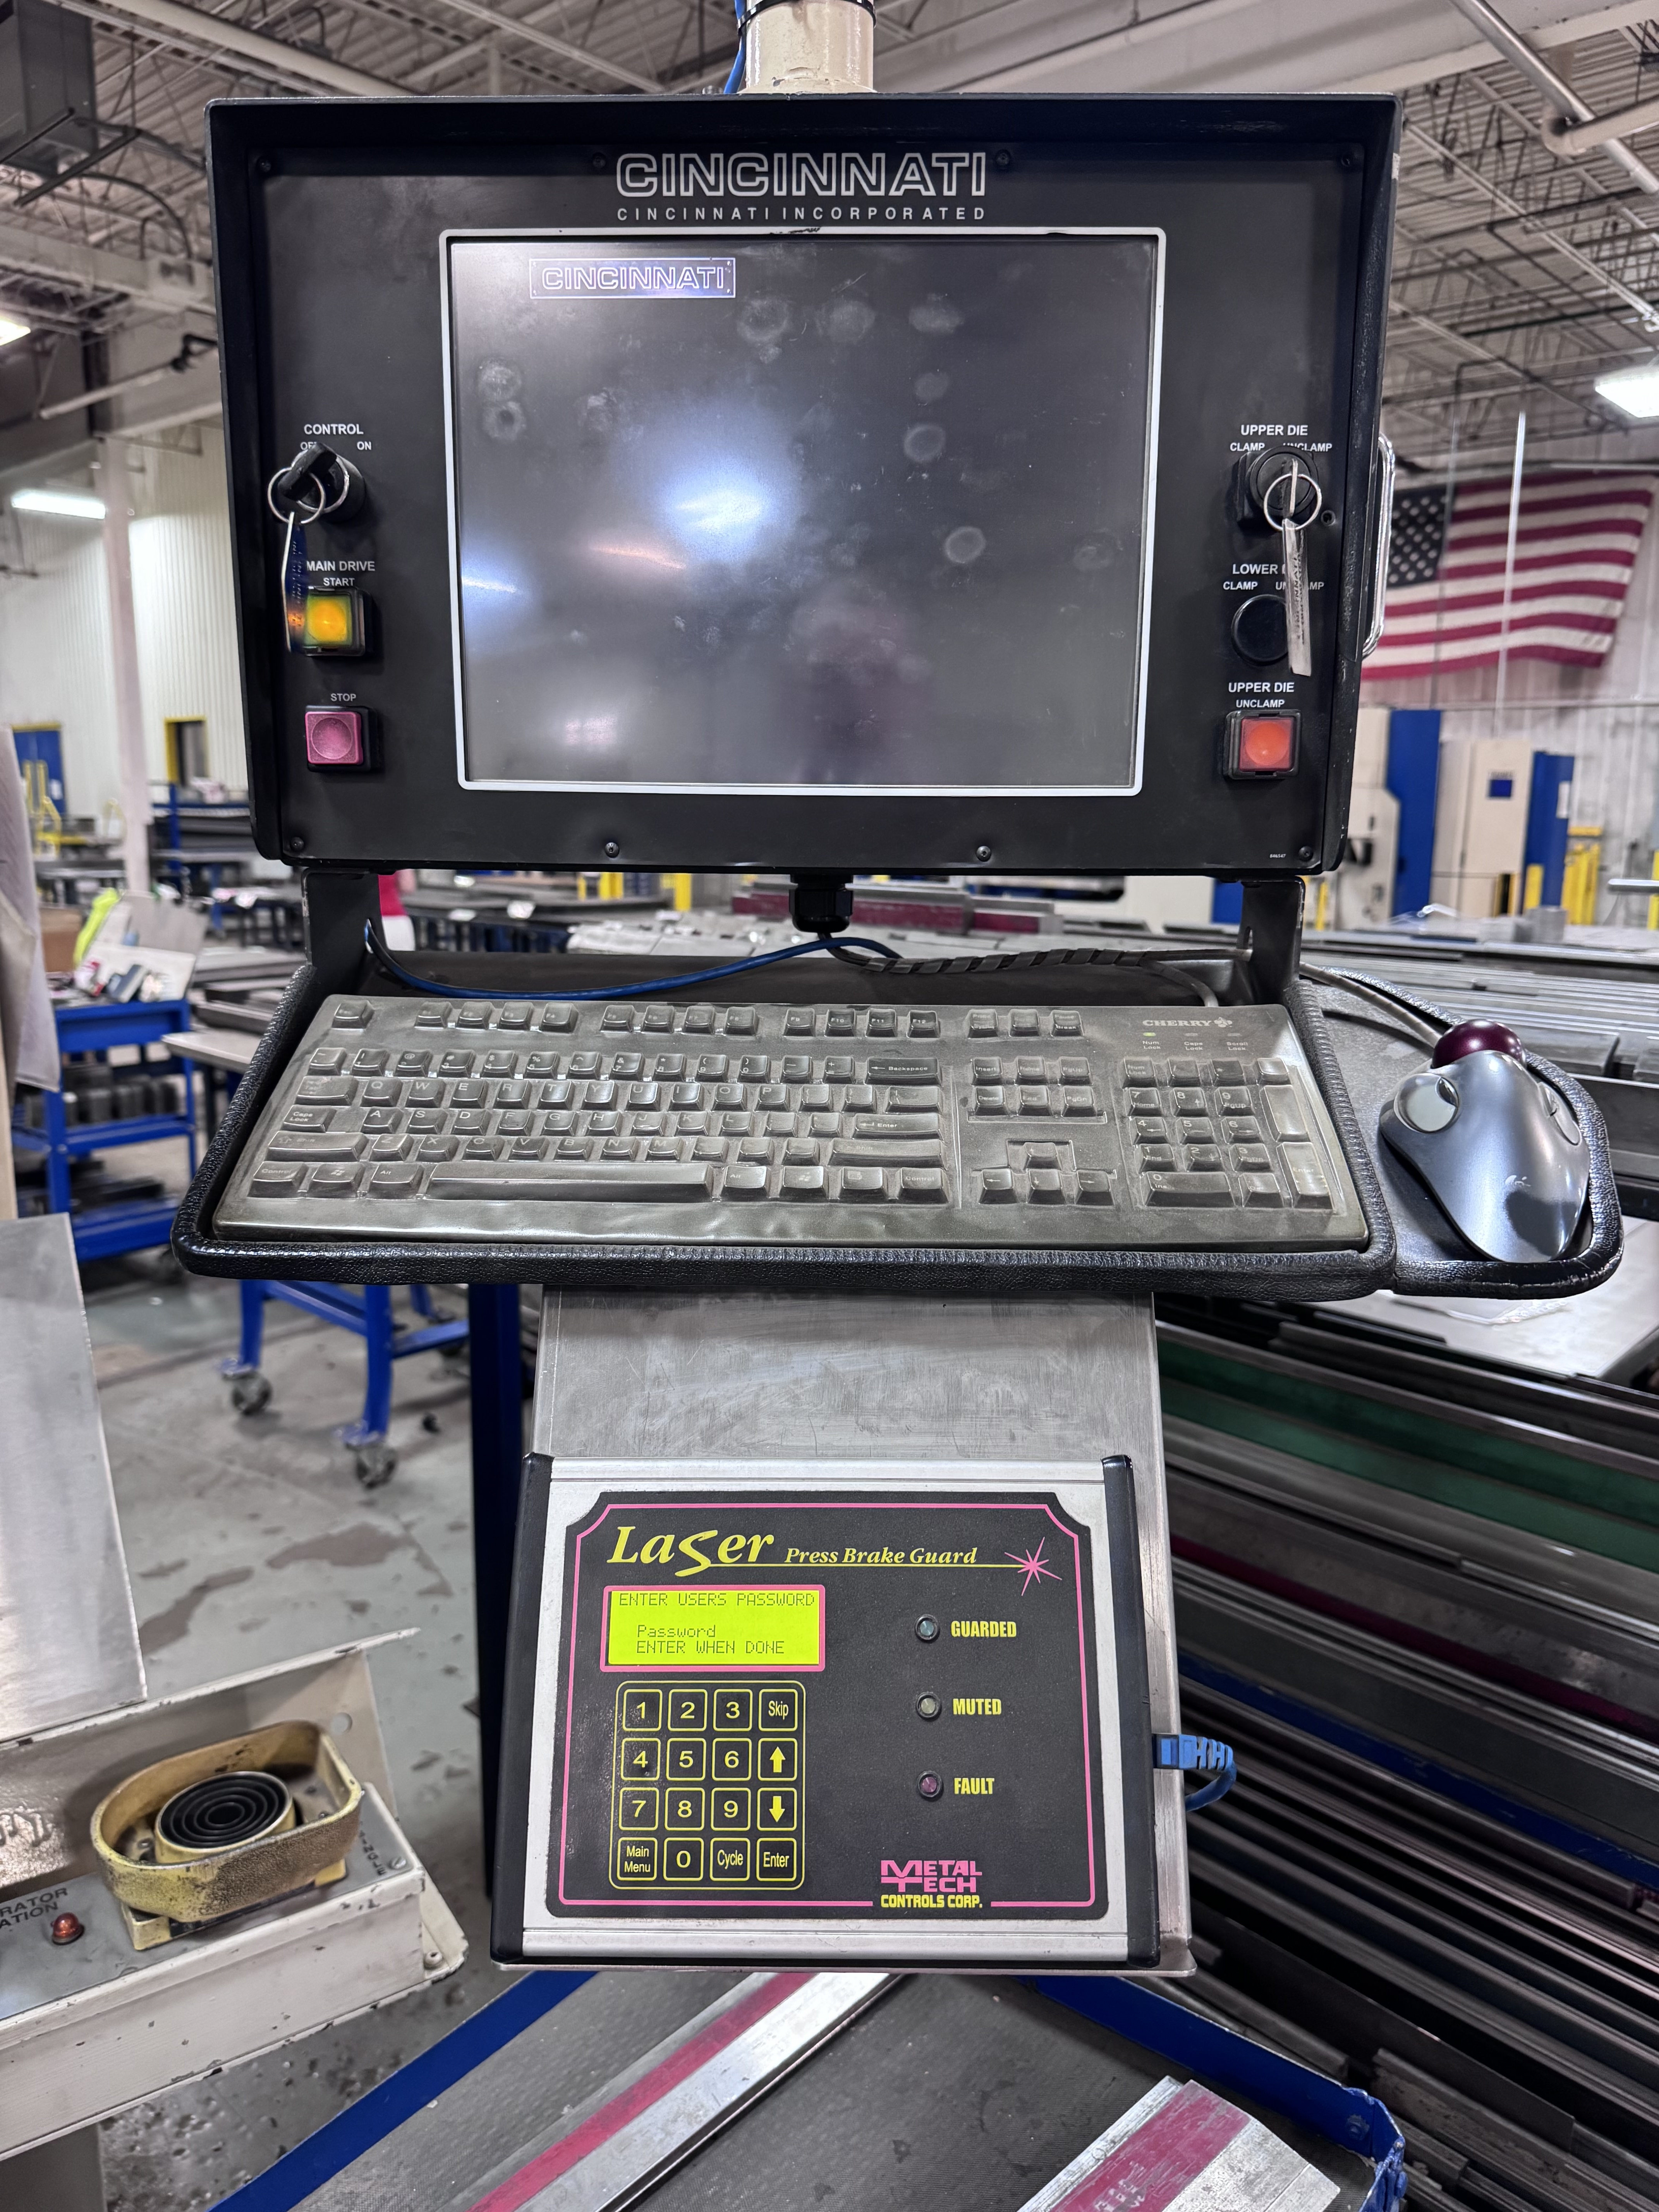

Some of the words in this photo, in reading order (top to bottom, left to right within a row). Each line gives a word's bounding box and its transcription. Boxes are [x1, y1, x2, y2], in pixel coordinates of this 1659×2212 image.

[617, 153, 986, 197] CINCINNATI
[618, 207, 769, 221] CINCINNATI
[783, 206, 985, 220] INCORPORATED
[542, 267, 724, 290] CINCINNATI
[304, 424, 364, 434] CONTROL
[1241, 425, 1284, 435] UPPER
[1287, 425, 1308, 436] DIE
[300, 442, 317, 450] OF
[357, 441, 371, 450] ON
[1230, 443, 1265, 451] CLAMP
[306, 561, 335, 571] MAIN
[339, 561, 375, 571] DRIVE
[1233, 564, 1278, 574] LOWER
[323, 578, 355, 586] START
[1223, 582, 1258, 590] CLAMP
[1276, 582, 1324, 590] UNMP
[1229, 682, 1271, 692] UPPER
[1274, 682, 1295, 692] DIE
[1236, 699, 1285, 708] UNCLAMP
[371, 1081, 383, 1090] Q
[415, 1082, 430, 1091] W
[607, 1526, 774, 1577] Laser
[784, 1548, 838, 1563] Press
[842, 1547, 905, 1563] Brake
[910, 1547, 977, 1564] Guard
[620, 1593, 667, 1606] ENTER
[678, 1593, 726, 1606] USERS
[737, 1593, 814, 1606] PASSWORD
[637, 1625, 715, 1638] Password
[951, 1621, 1017, 1637] GUARDED
[637, 1641, 686, 1654] ENTER
[696, 1641, 735, 1654] WHEN
[745, 1641, 784, 1654] DONE
[637, 1702, 646, 1719] 1
[680, 1702, 695, 1719] 2
[726, 1702, 740, 1719] 3
[768, 1700, 788, 1720] Skip
[953, 1698, 1001, 1715] MUTED
[633, 1751, 648, 1767] 4
[679, 1751, 693, 1768] 5
[724, 1751, 739, 1768] 6
[954, 1778, 994, 1794] FAULT
[632, 1800, 646, 1817] 7
[677, 1800, 692, 1818] 8
[723, 1801, 738, 1817] 9
[626, 1846, 649, 1857] Main
[624, 1861, 651, 1872] Menu
[717, 1850, 743, 1869] Cycle
[763, 1852, 789, 1867] Enter
[881, 1860, 982, 1878] METAL
[881, 1877, 976, 1893] TECH
[881, 1894, 945, 1908] CONTROLS
[948, 1895, 982, 1908] CORP.
